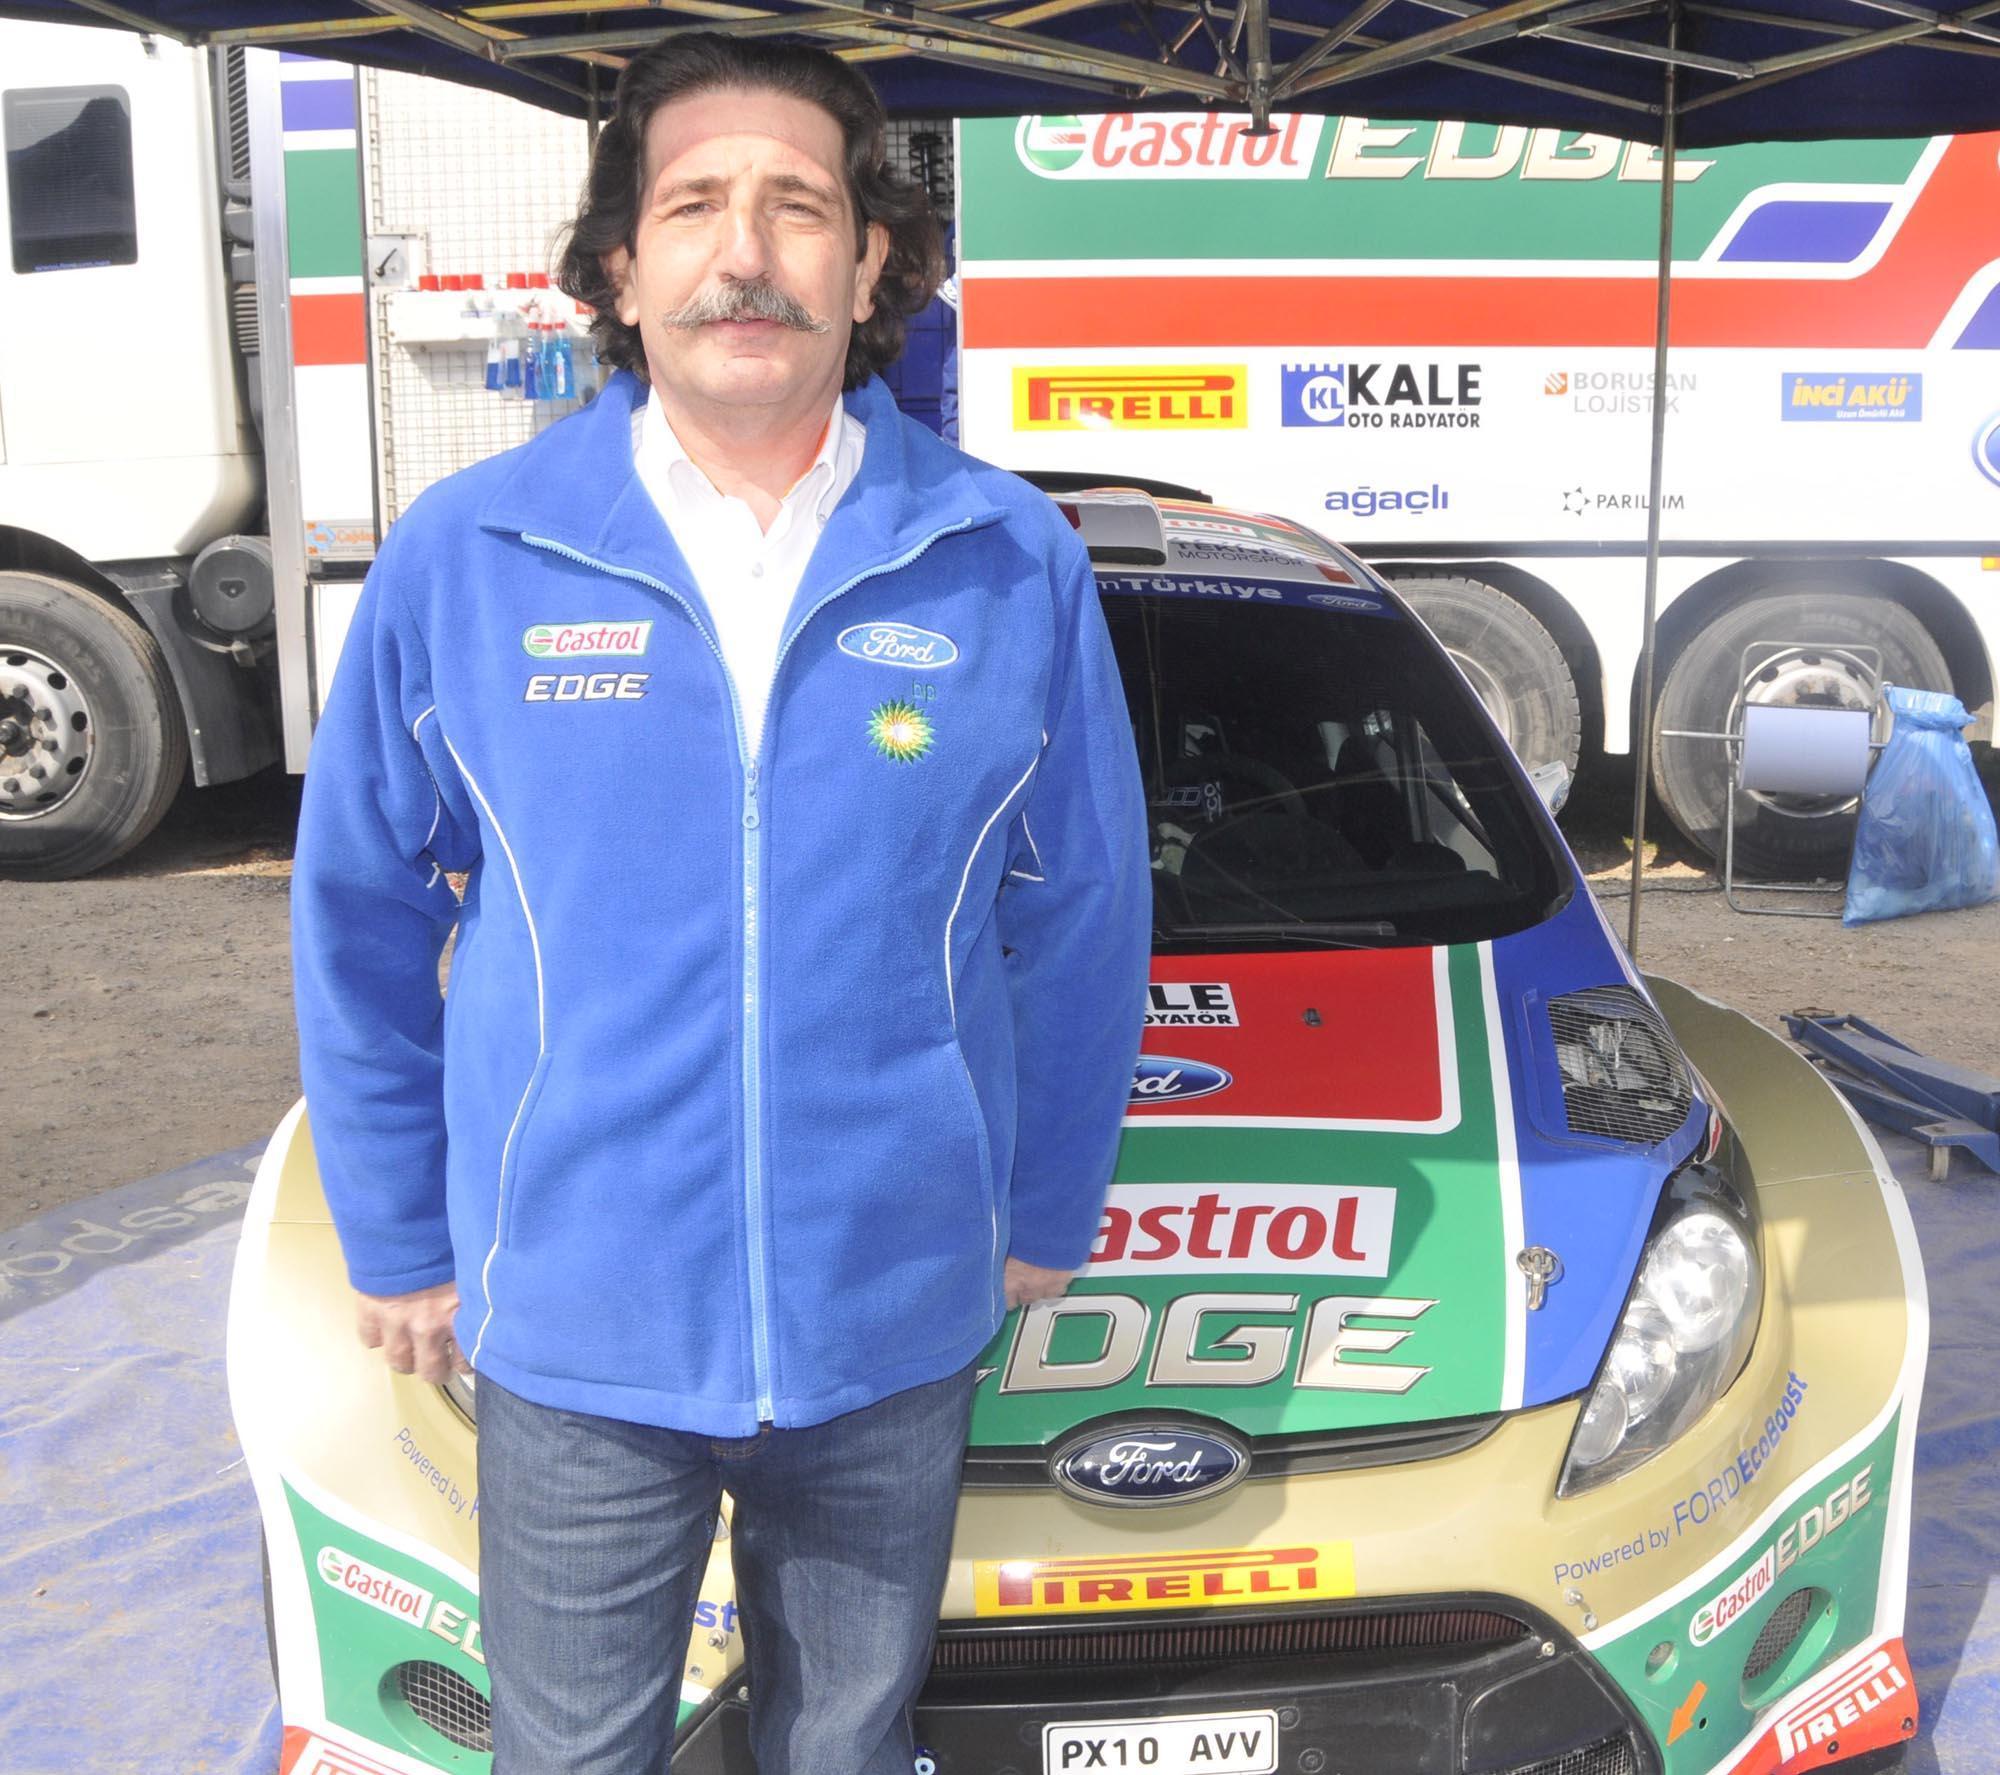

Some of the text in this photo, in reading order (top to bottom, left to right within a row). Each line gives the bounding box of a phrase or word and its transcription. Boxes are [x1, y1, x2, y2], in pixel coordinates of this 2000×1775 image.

[1092, 113, 1299, 168] Castrol
[1028, 375, 1235, 421] PIRELLI
[1309, 388, 1344, 409] KL
[1348, 364, 1482, 406] KALE
[1573, 392, 1680, 414] LOJİSTK
[1847, 377, 1908, 407] AKÜ
[1348, 407, 1480, 428] OTO RADYATÖR
[1597, 494, 1684, 510] PARILIM
[554, 624, 641, 653] Castrol
[863, 627, 937, 665] Ford
[524, 672, 653, 702] EDGE
[1144, 1011, 1234, 1025] DYATÖR
[1148, 984, 1230, 1011] LE
[1089, 1194, 1368, 1263] astrol
[977, 1293, 1441, 1395] DGE
[393, 1427, 451, 1497] Powered
[448, 1483, 469, 1514] by
[1100, 1441, 1202, 1486] Ford
[1553, 1534, 1646, 1585] Powered
[1649, 1525, 1671, 1550] by
[1714, 1463, 1875, 1629] Castrol EDGE
[344, 1563, 423, 1619] Castrol
[998, 1547, 1319, 1607] PIRELLI
[1773, 1650, 1908, 1766] PIRELLI
[1060, 1730, 1263, 1769] PX10 AVV
